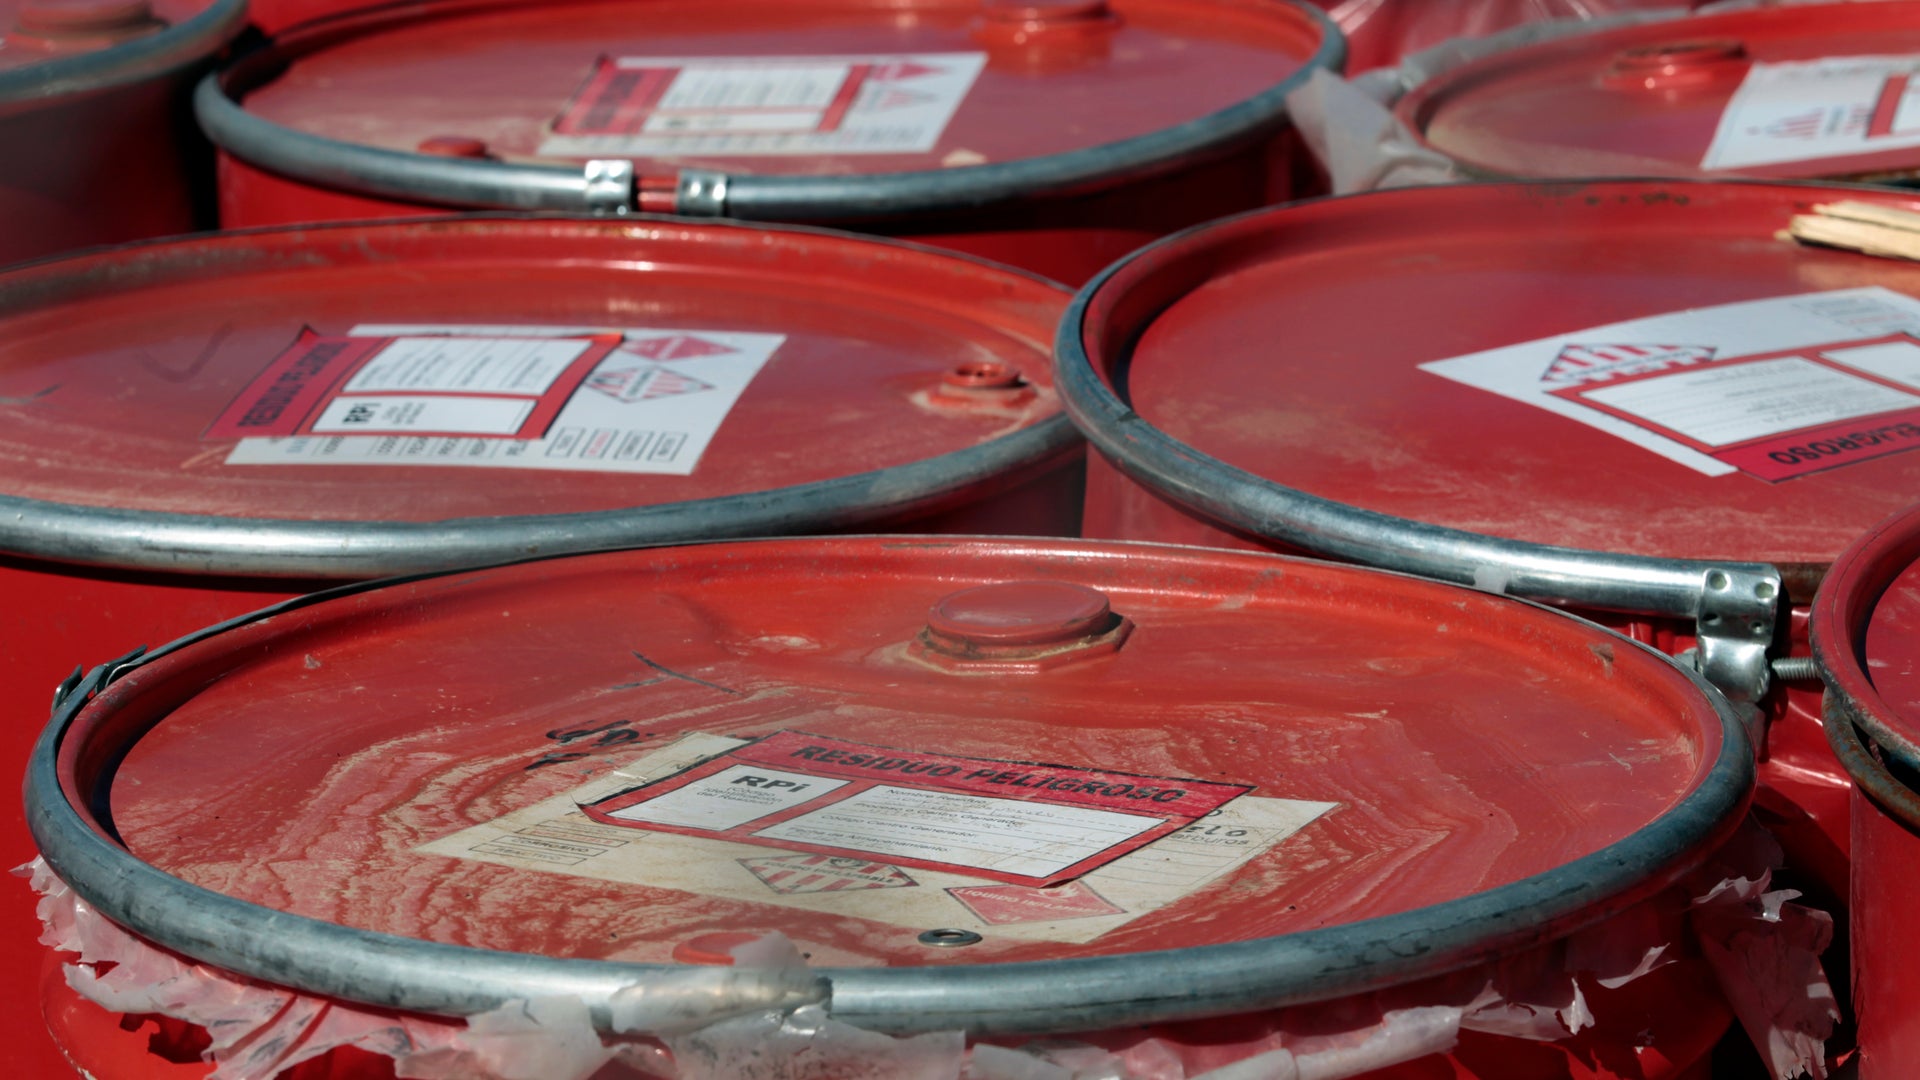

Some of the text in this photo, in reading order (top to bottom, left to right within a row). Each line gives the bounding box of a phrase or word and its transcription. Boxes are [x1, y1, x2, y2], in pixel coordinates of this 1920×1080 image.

[1768, 422, 1920, 465] ELIGROSO
[731, 775, 811, 793] RPi
[789, 744, 1189, 803] RESIDUO PELIGROSO
[887, 788, 934, 799] Nombre
